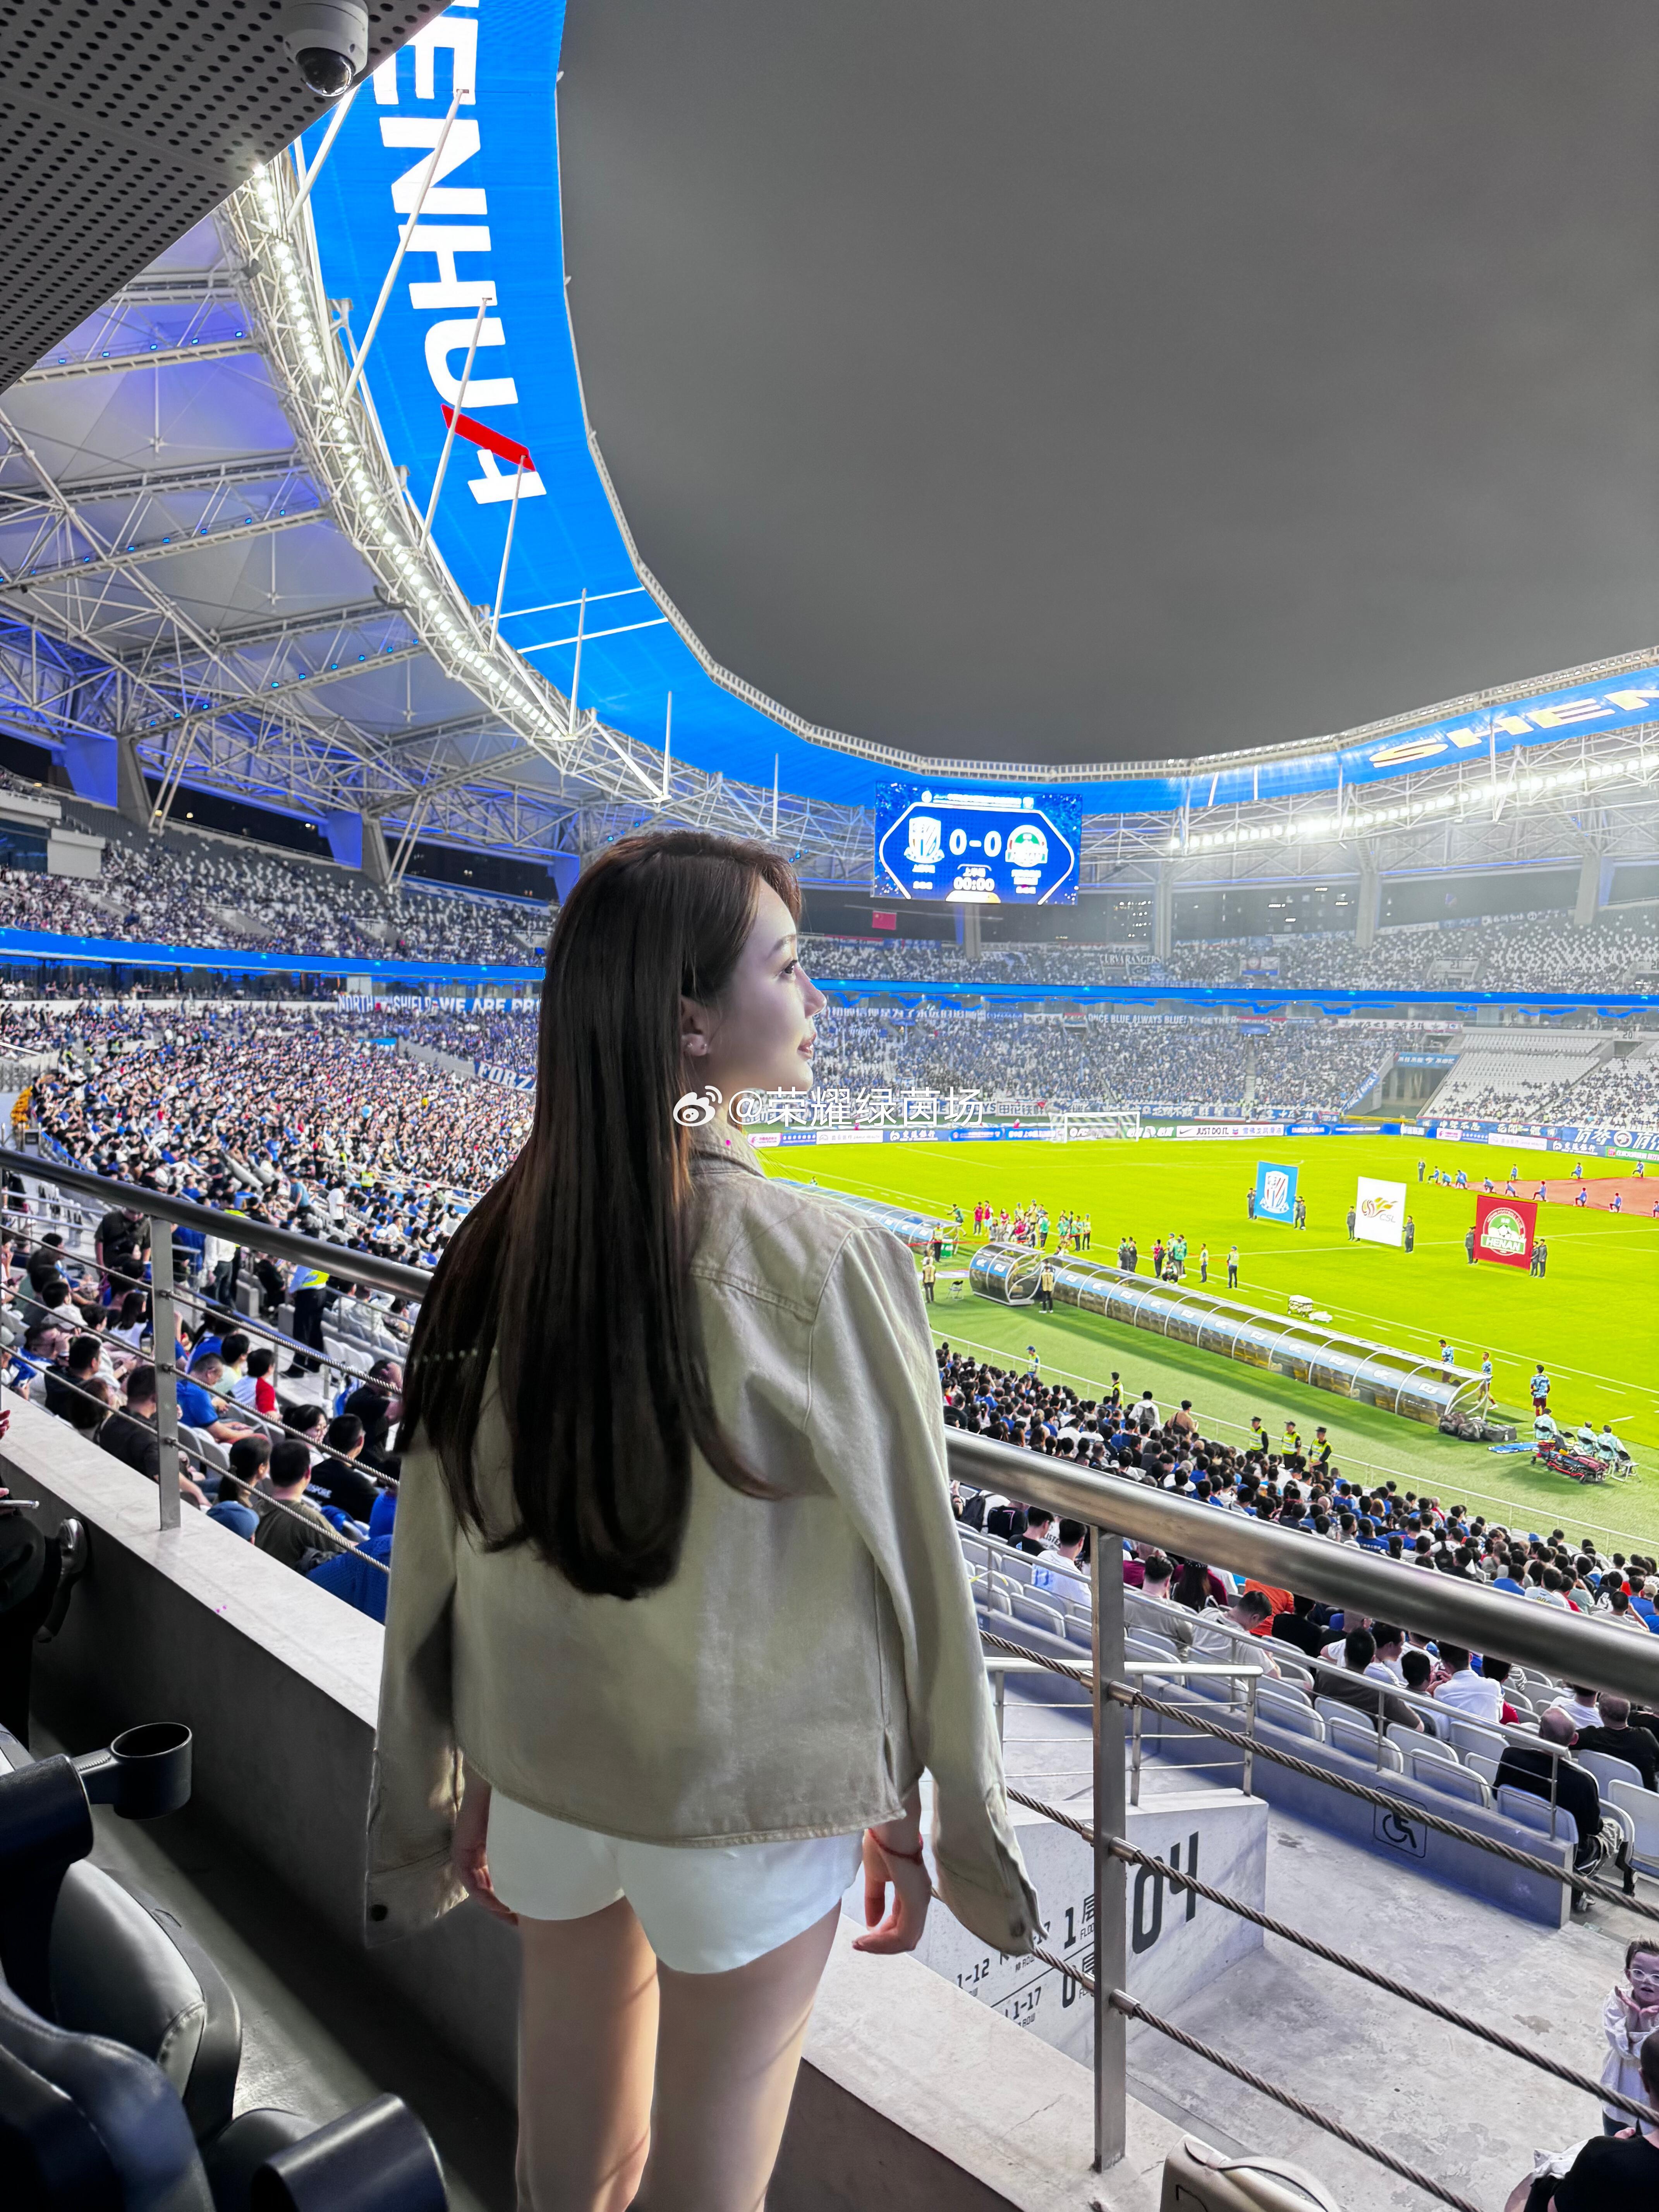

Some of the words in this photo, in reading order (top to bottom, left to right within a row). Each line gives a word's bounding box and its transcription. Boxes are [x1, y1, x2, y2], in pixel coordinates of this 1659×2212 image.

[373, 0, 546, 504] ENHUA
[953, 876, 995, 891] 00:00
[338, 995, 373, 1013] NORTH
[439, 998, 466, 1015] WE
[472, 998, 506, 1015] ARE
[1088, 1013, 1109, 1023] ONCE
[1111, 1014, 1130, 1024] BLUE
[1132, 1015, 1162, 1024] ALWAYS
[1164, 1015, 1187, 1024] BLUE!
[1379, 1213, 1396, 1223] CSL
[1486, 1237, 1521, 1251] HENAN
[1002, 1510, 1016, 1530] 7
[1132, 1831, 1199, 1954] 04
[1013, 1986, 1041, 2020] 1-17
